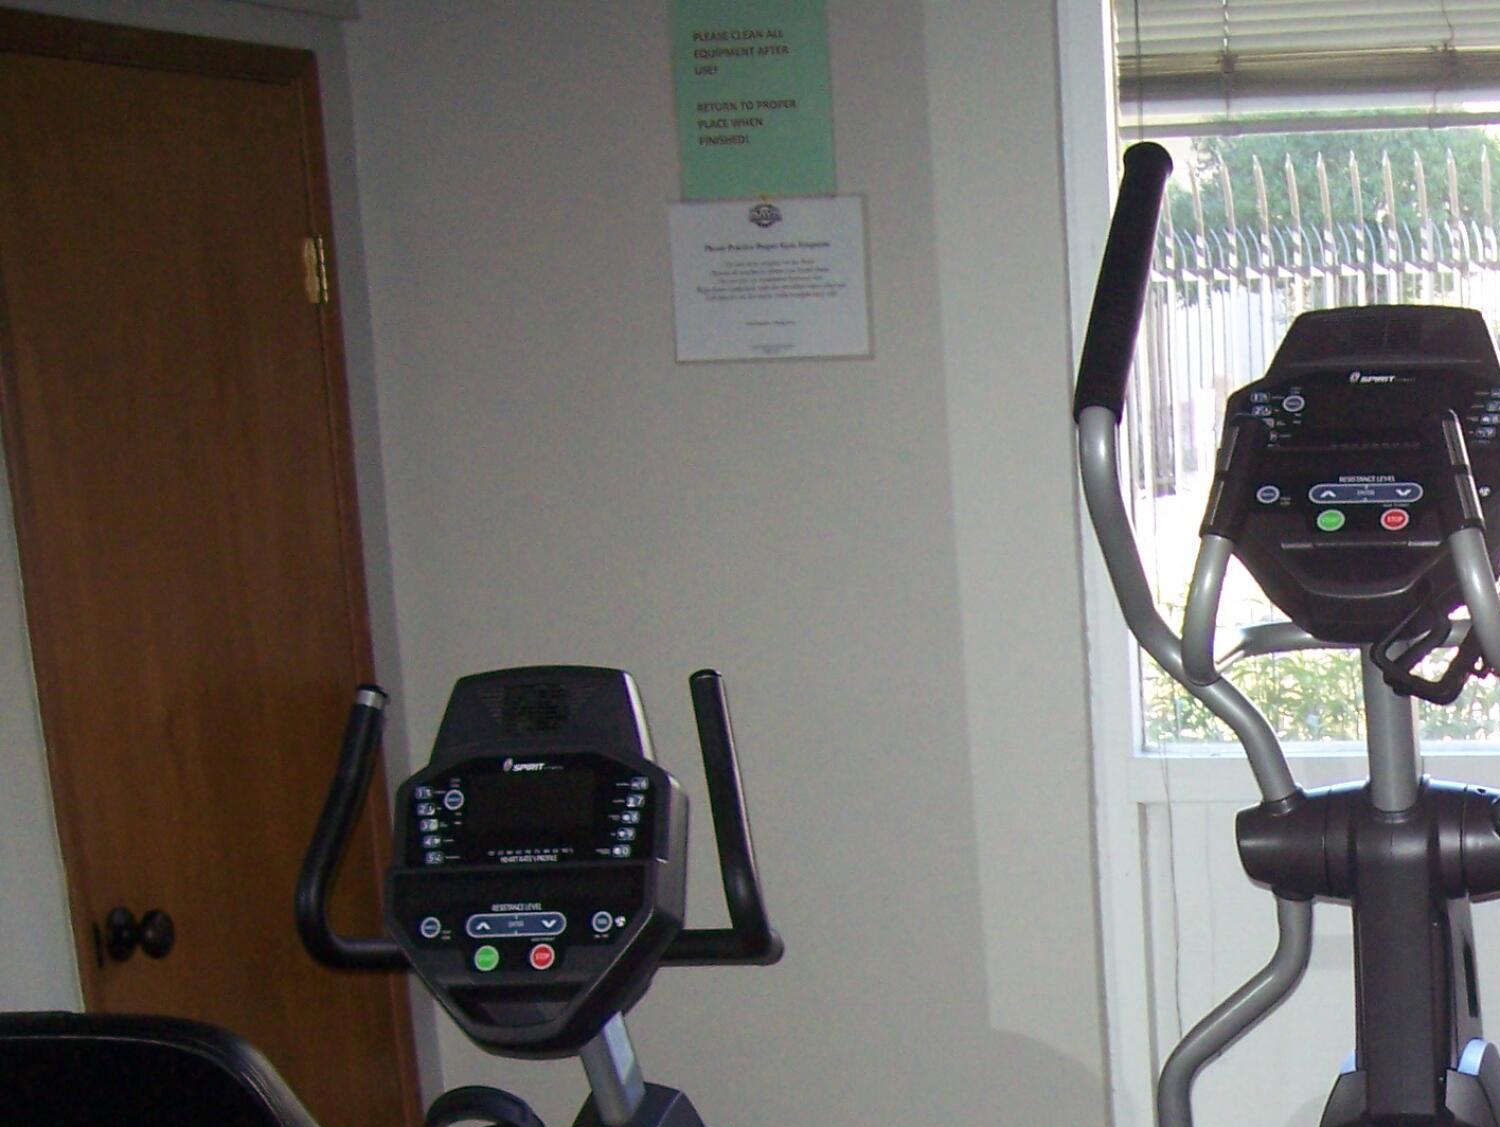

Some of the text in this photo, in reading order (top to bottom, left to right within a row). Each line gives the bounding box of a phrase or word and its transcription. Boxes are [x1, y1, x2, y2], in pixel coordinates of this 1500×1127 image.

[692, 29, 784, 42] PLEASE CLEAN ALL
[694, 45, 789, 60] EQUIPMENT AFTER
[697, 99, 796, 113] RETURN TO PROPER
[698, 118, 763, 129] PLACE WHEN
[1360, 375, 1395, 383] SPIRIT
[513, 762, 545, 772] SPIRIT
